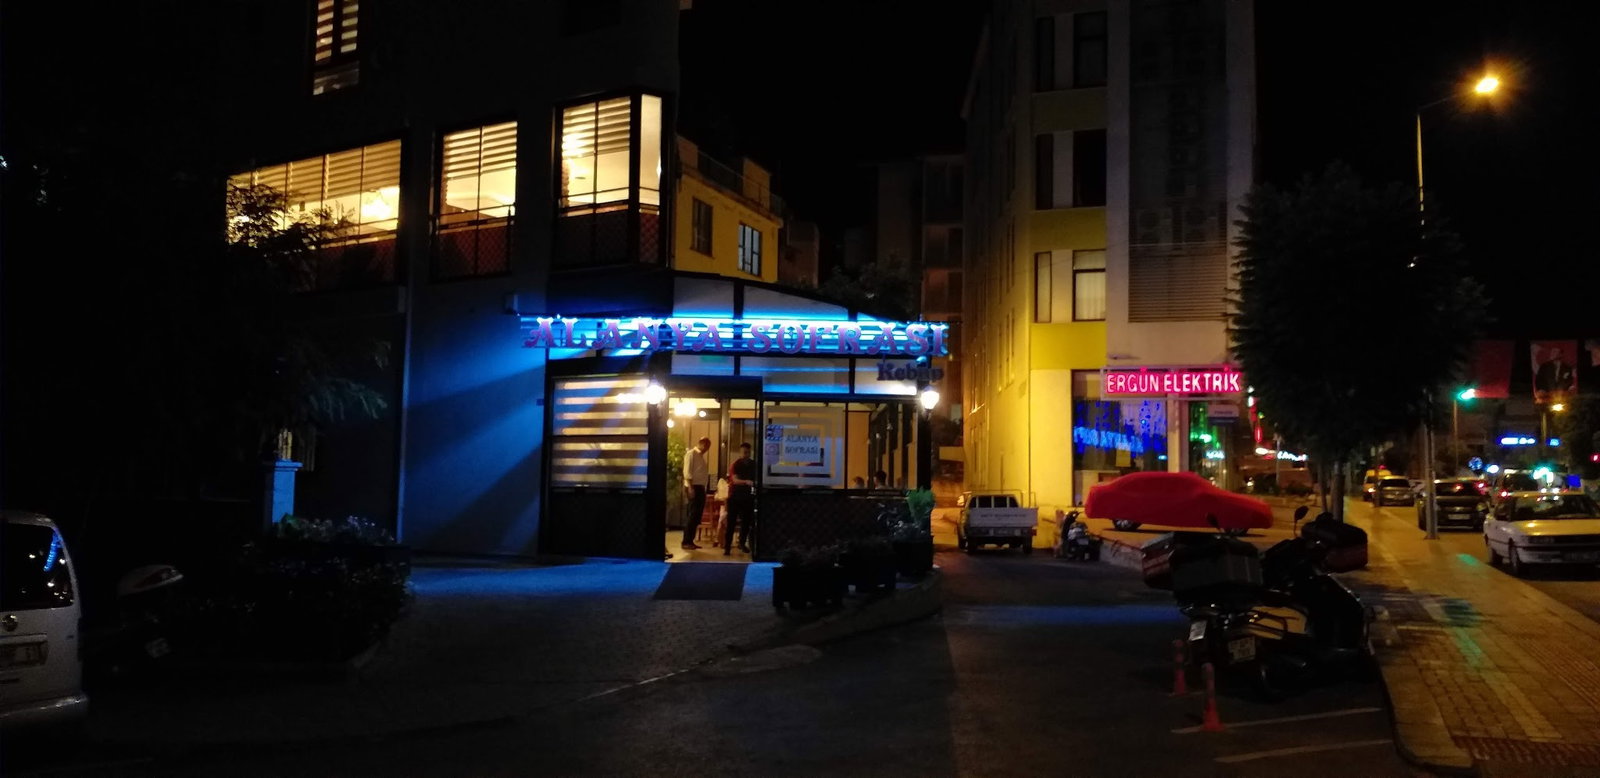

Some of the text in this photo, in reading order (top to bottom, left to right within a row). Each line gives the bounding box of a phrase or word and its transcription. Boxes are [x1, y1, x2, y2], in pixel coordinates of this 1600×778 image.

[523, 317, 949, 355] ALANYA SOFRASI
[1106, 366, 1160, 393] ERGÜN
